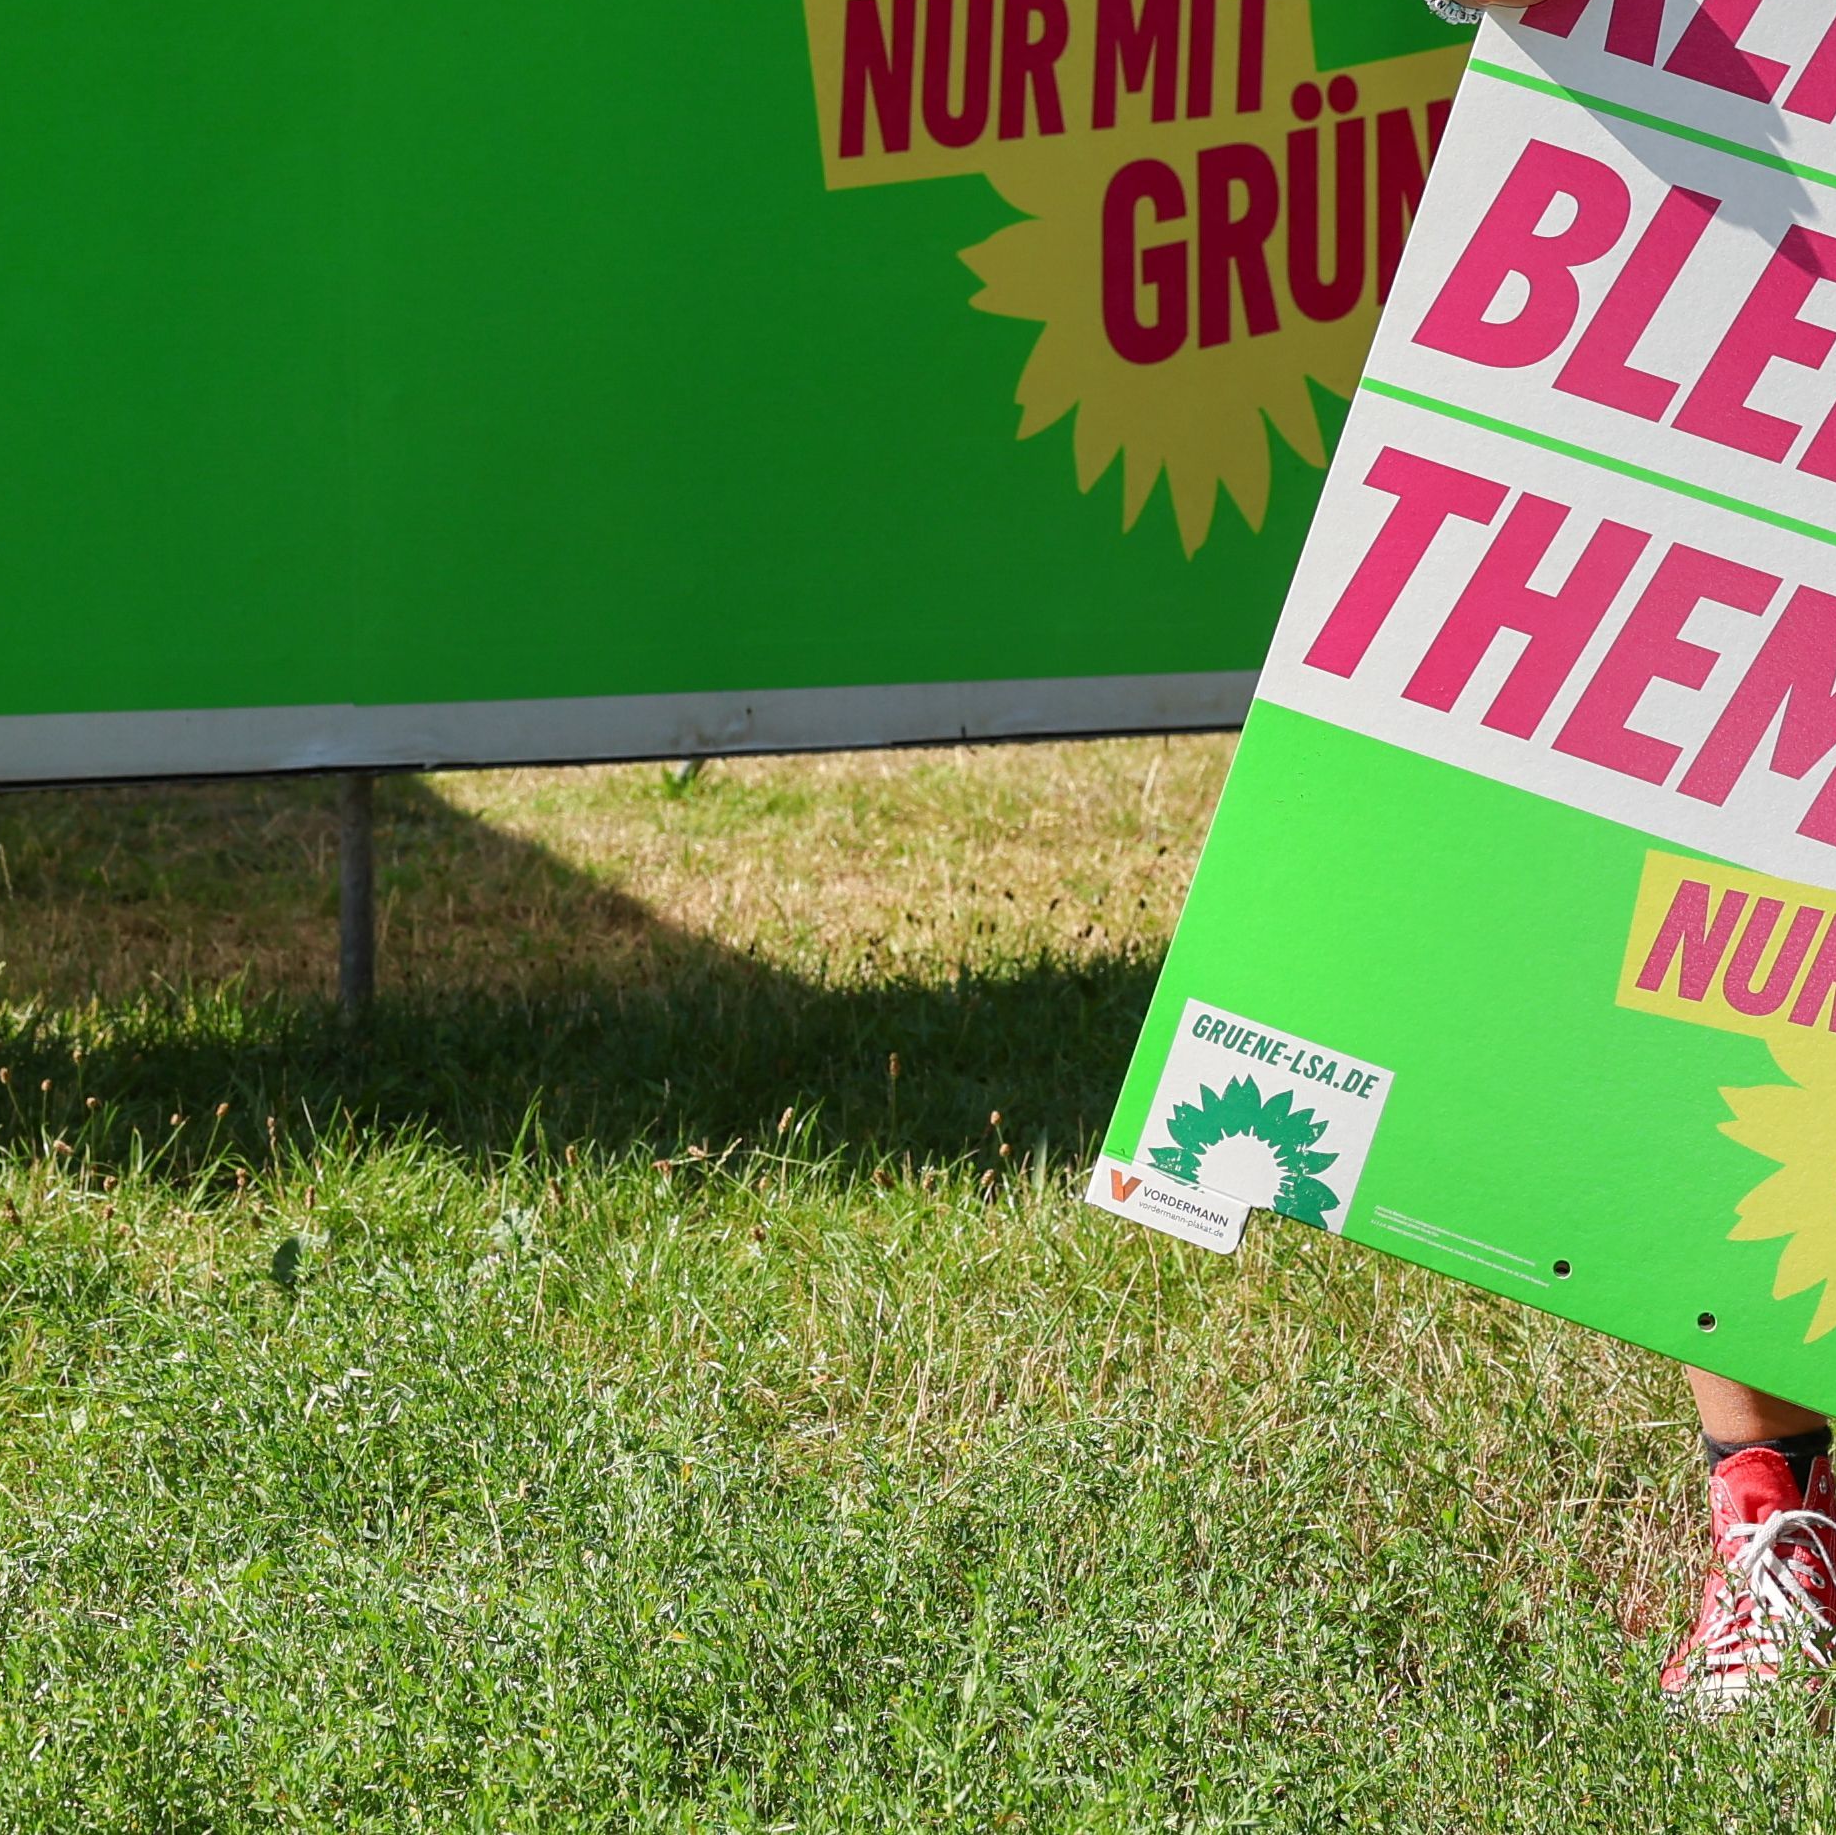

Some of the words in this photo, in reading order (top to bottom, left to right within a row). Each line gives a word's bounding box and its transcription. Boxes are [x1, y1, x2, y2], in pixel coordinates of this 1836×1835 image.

[1191, 1013, 1381, 1100] GRUENE-LSA.DE
[1137, 1201, 1225, 1239] vordermann-plakat.de
[1142, 1186, 1229, 1228] VORDERMANN
